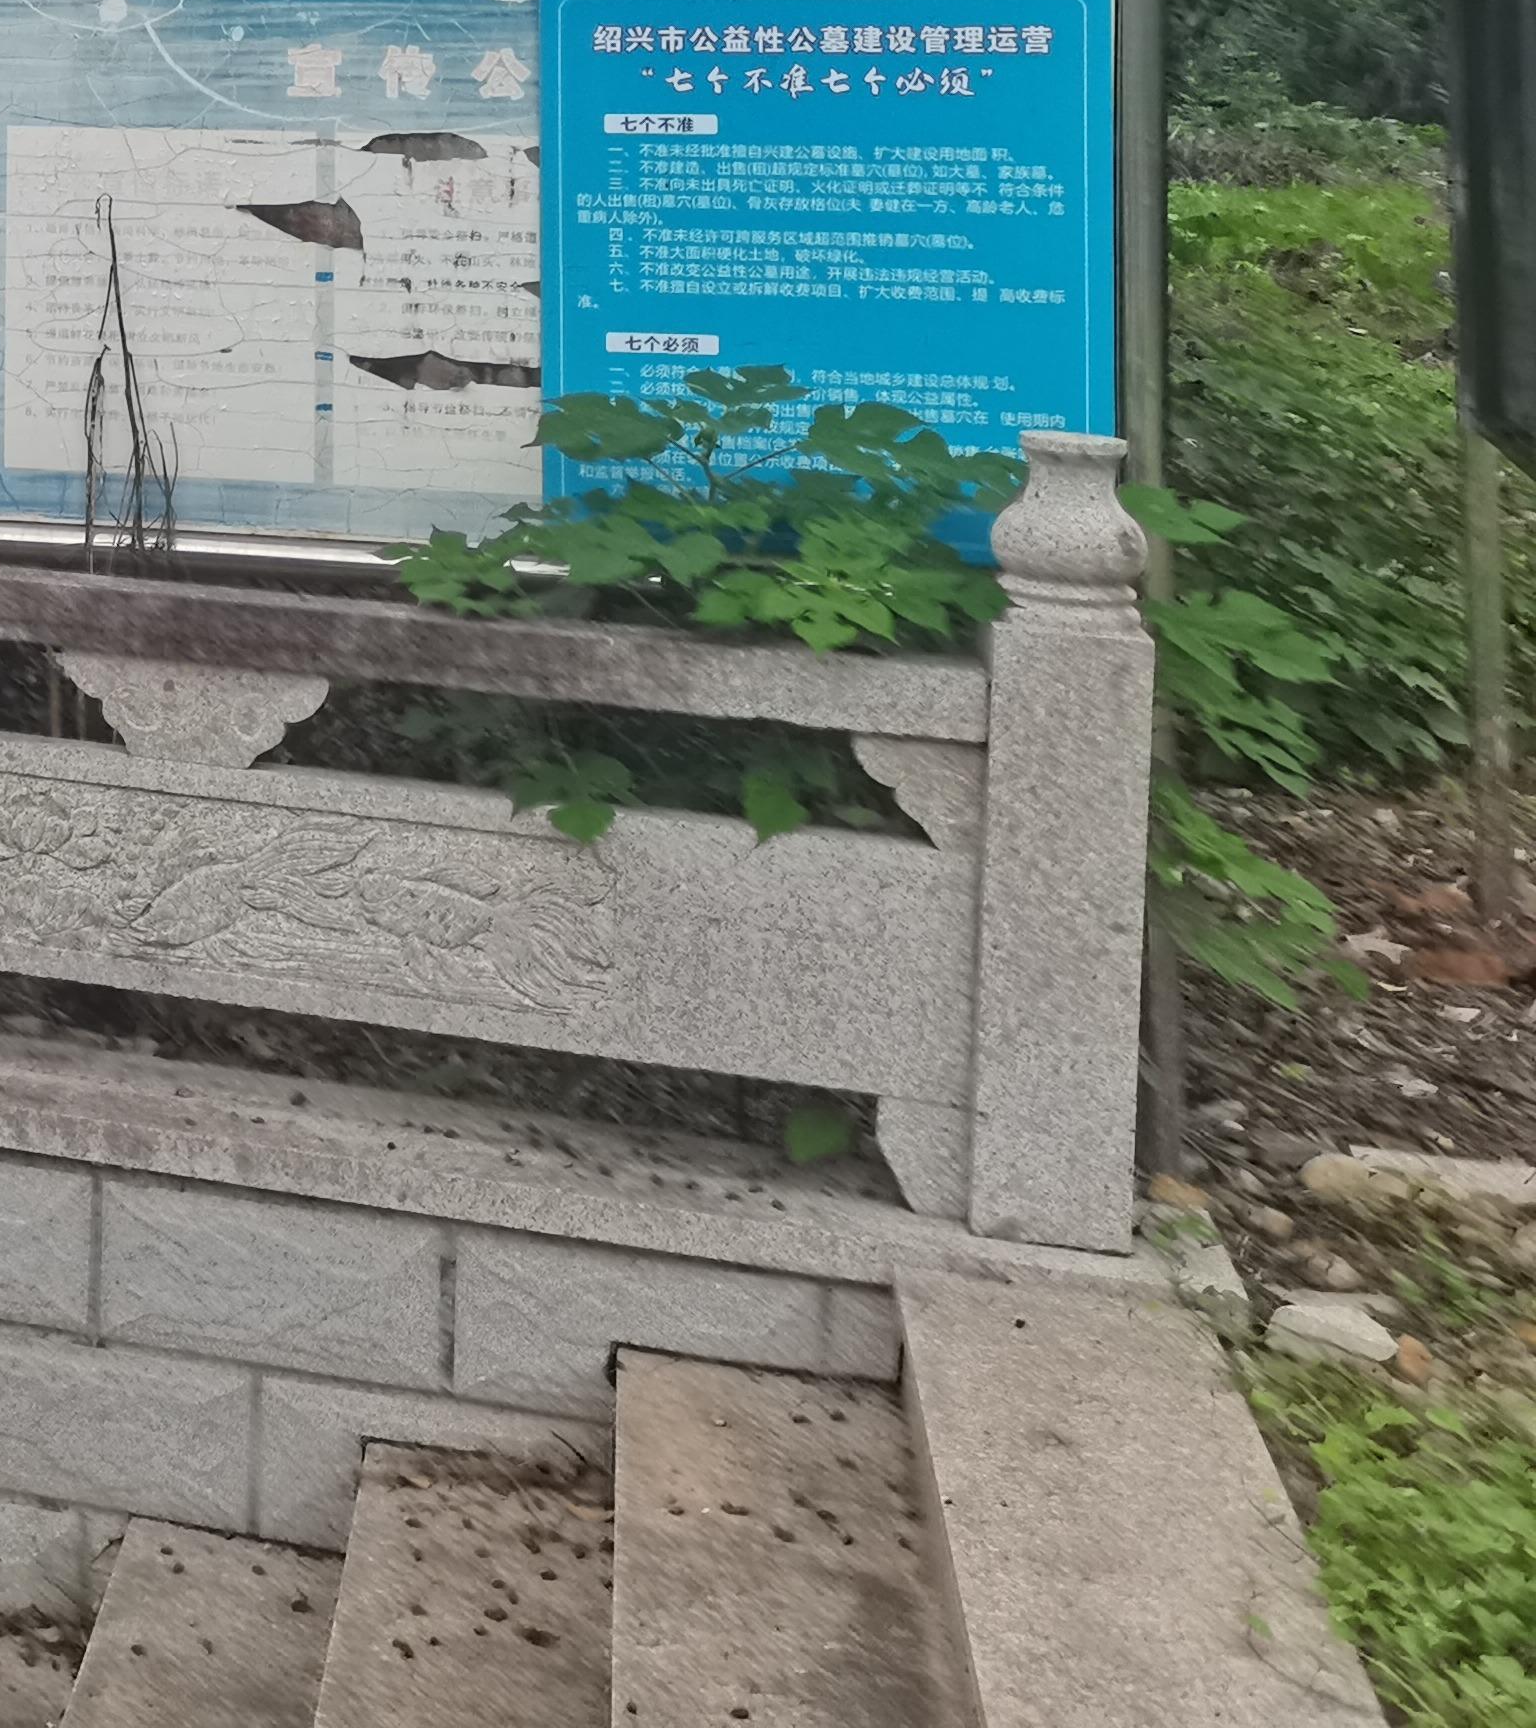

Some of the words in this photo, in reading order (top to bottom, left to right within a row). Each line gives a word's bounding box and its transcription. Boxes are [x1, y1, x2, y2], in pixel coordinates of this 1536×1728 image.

[592, 24, 1053, 55] 绍兴市公益性公墓建设管理运营
[640, 63, 994, 100] “七个不准七个必须”
[620, 116, 695, 133] 七个不准
[576, 210, 664, 227] 重病人除外)。
[576, 294, 600, 309] 准。
[624, 334, 700, 353] 七个必须
